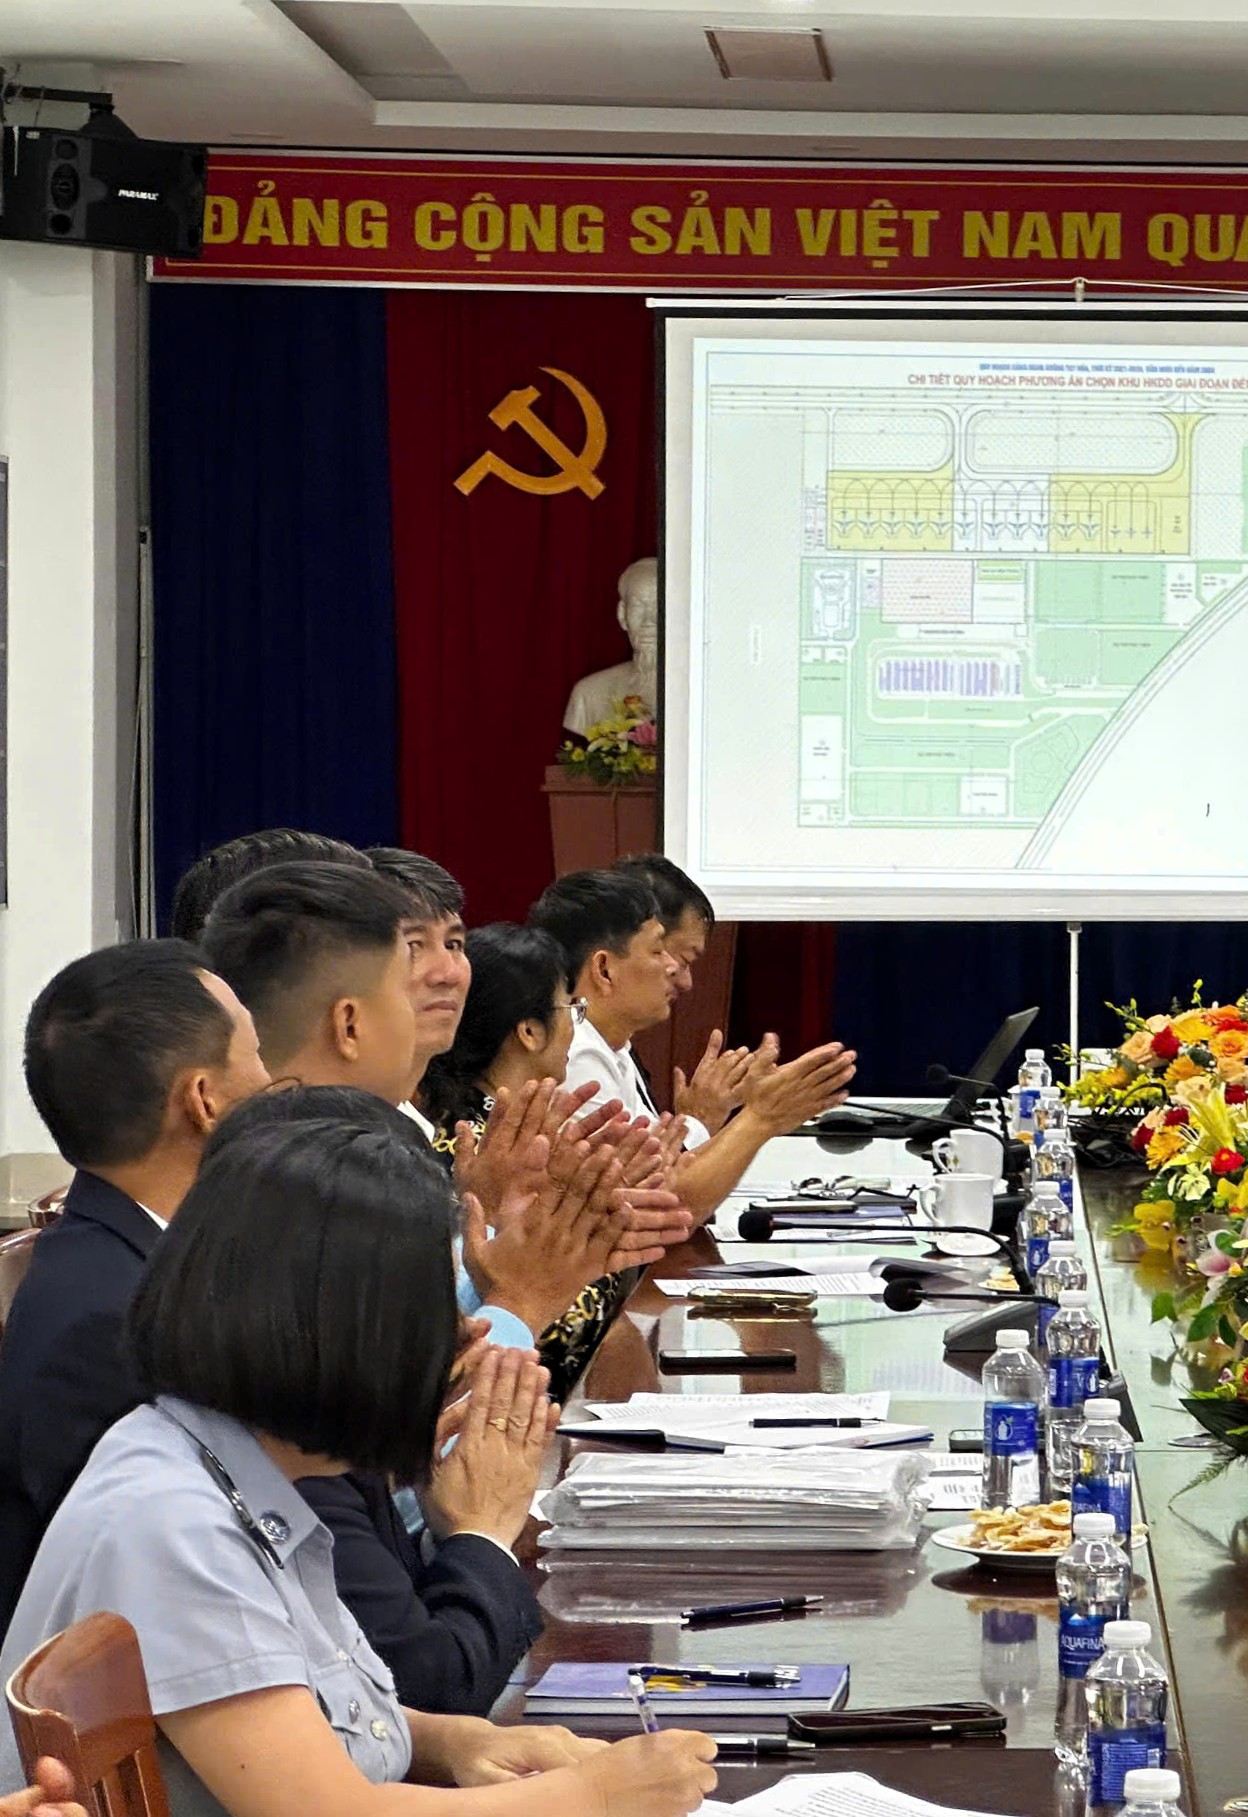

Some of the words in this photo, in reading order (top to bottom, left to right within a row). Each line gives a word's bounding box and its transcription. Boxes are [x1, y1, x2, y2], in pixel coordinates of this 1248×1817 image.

[203, 180, 388, 250] ĐẢNG
[414, 192, 606, 262] CỘNG
[629, 189, 771, 256] SẢN
[795, 198, 940, 268] VIỆT
[962, 211, 1122, 260] NAM
